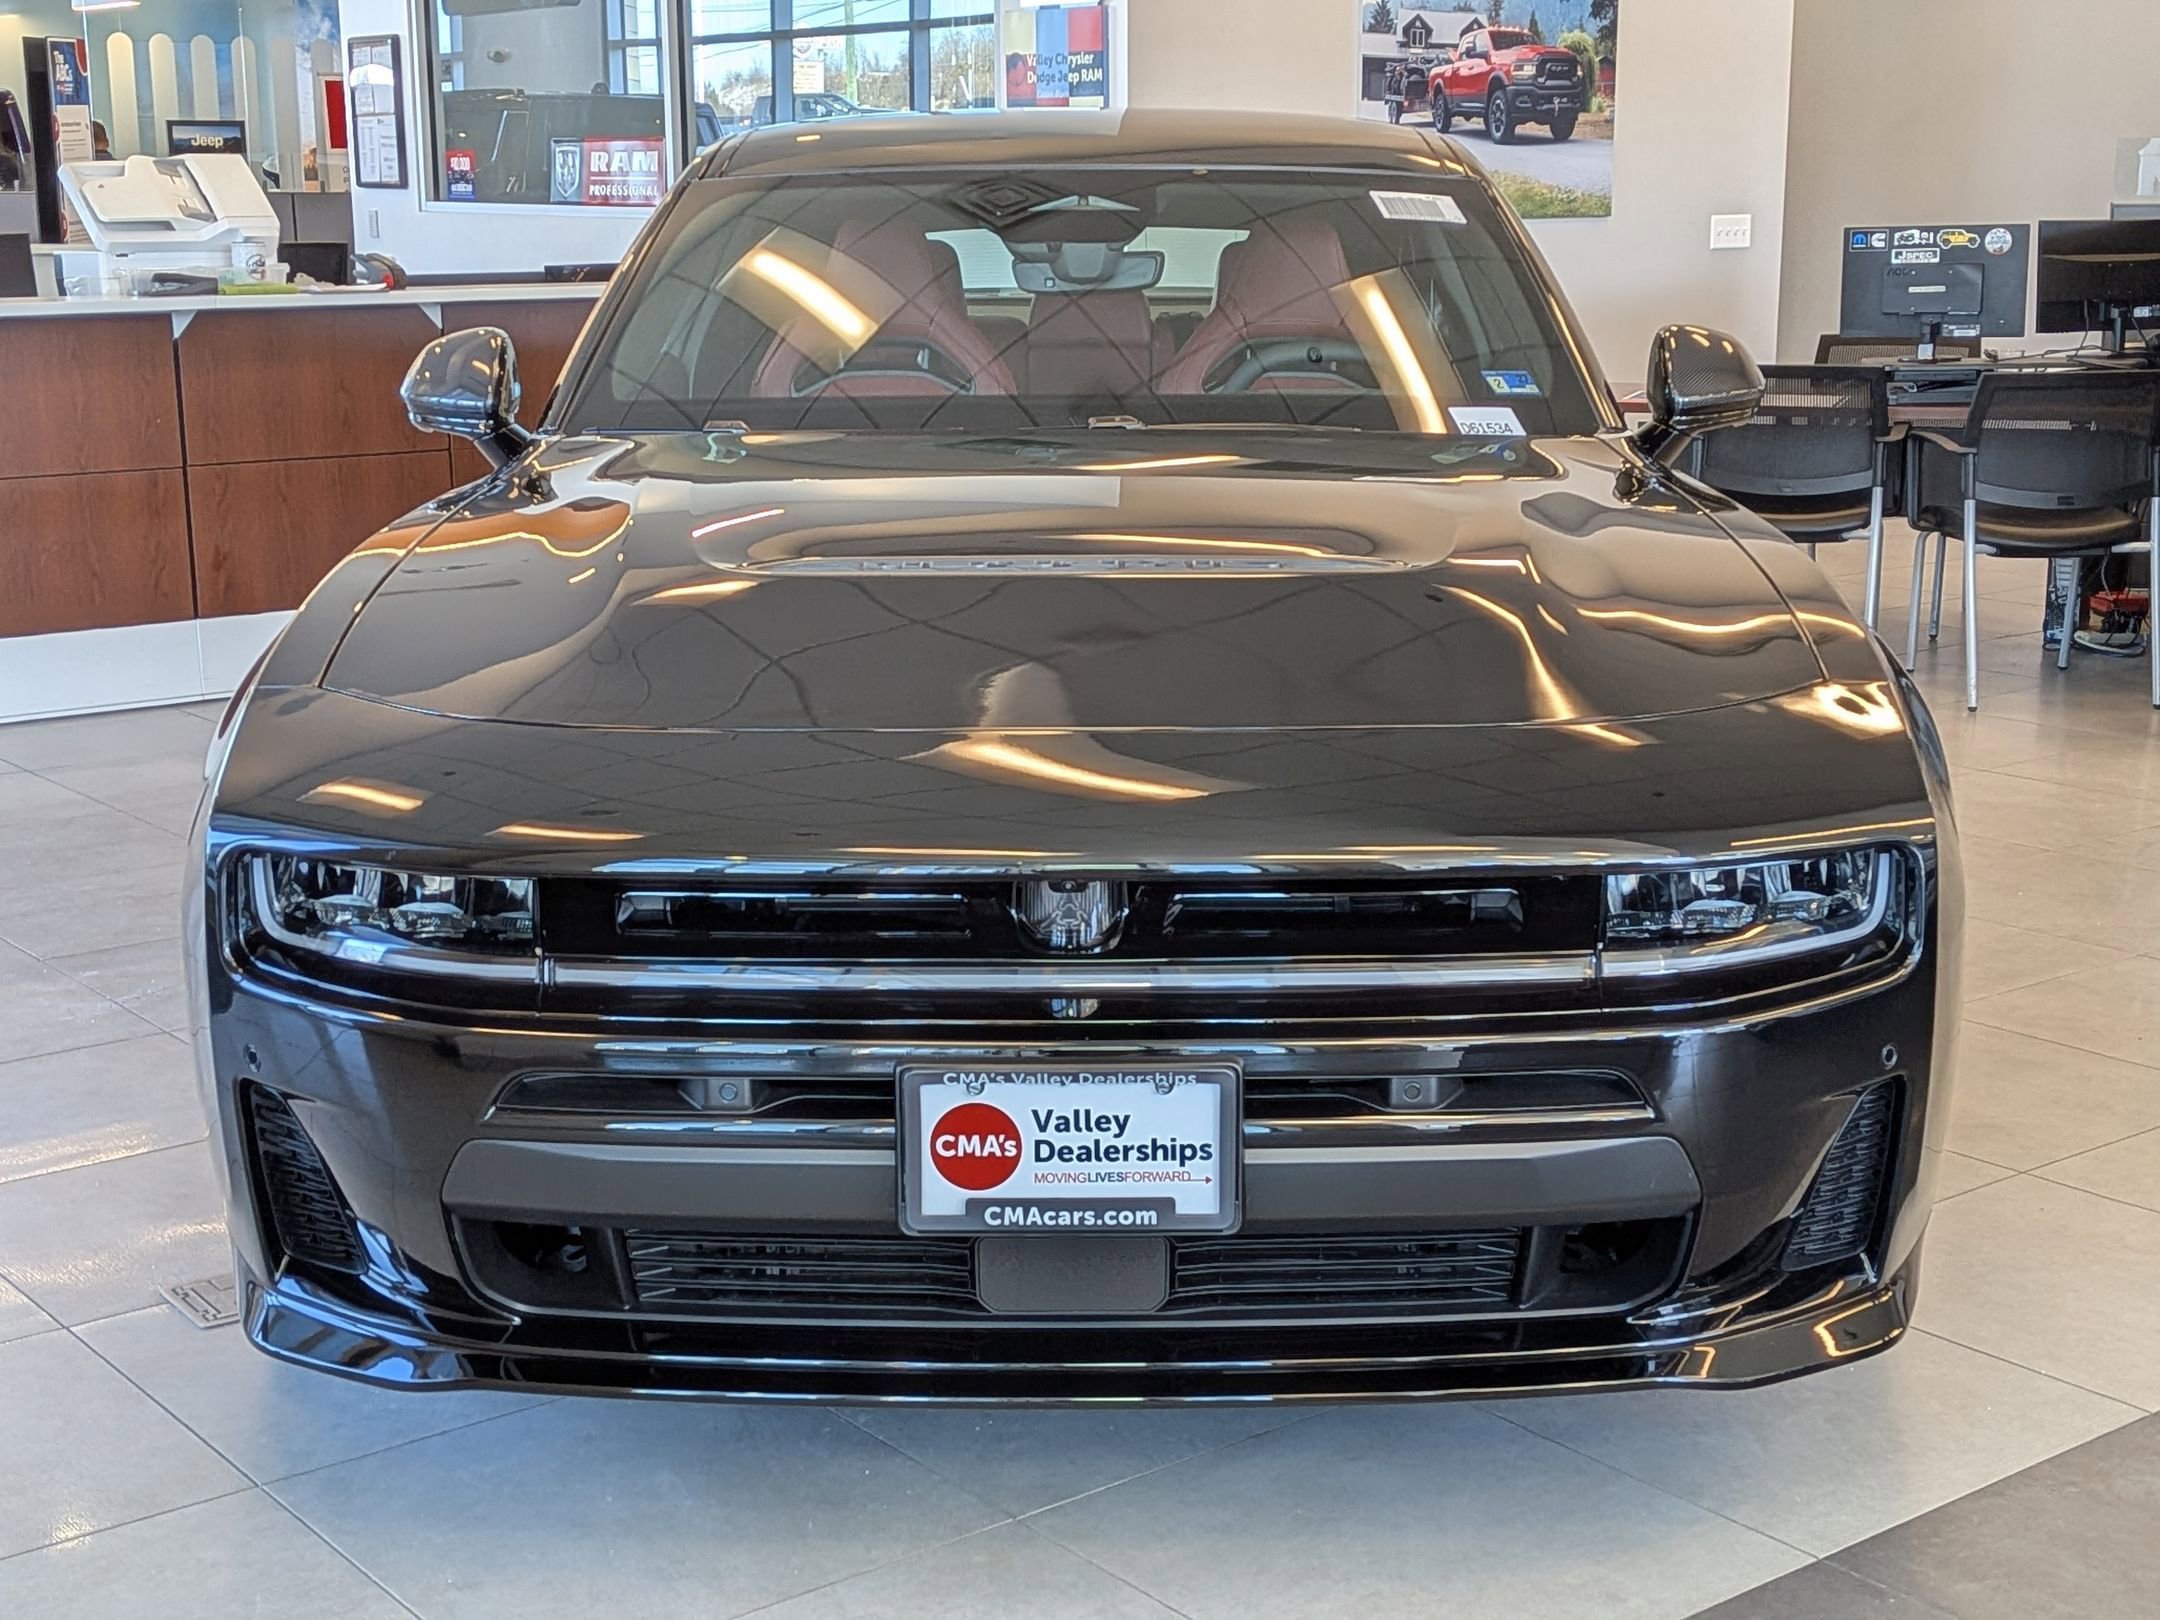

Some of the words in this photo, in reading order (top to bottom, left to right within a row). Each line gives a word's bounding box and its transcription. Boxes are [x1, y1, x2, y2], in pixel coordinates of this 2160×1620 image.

[1027, 53, 1053, 69] Valley
[1055, 51, 1095, 68] Chrysler
[1027, 70, 1056, 86] Dodge
[1057, 70, 1079, 85] Jeep
[1081, 67, 1103, 82] RAM
[191, 133, 224, 149] Jeep
[590, 150, 659, 172] RAM
[588, 184, 659, 197] PROFESSIONAL
[1459, 422, 1514, 435] D61534
[943, 1072, 1005, 1086] CMA's
[1011, 1072, 1074, 1086] Valley
[1079, 1071, 1197, 1086] Dealerships
[1032, 1108, 1131, 1138] Valley
[935, 1133, 1018, 1158] CMA's
[1034, 1138, 1214, 1167] Dealerships
[984, 1205, 1158, 1227] CMAcars.com
